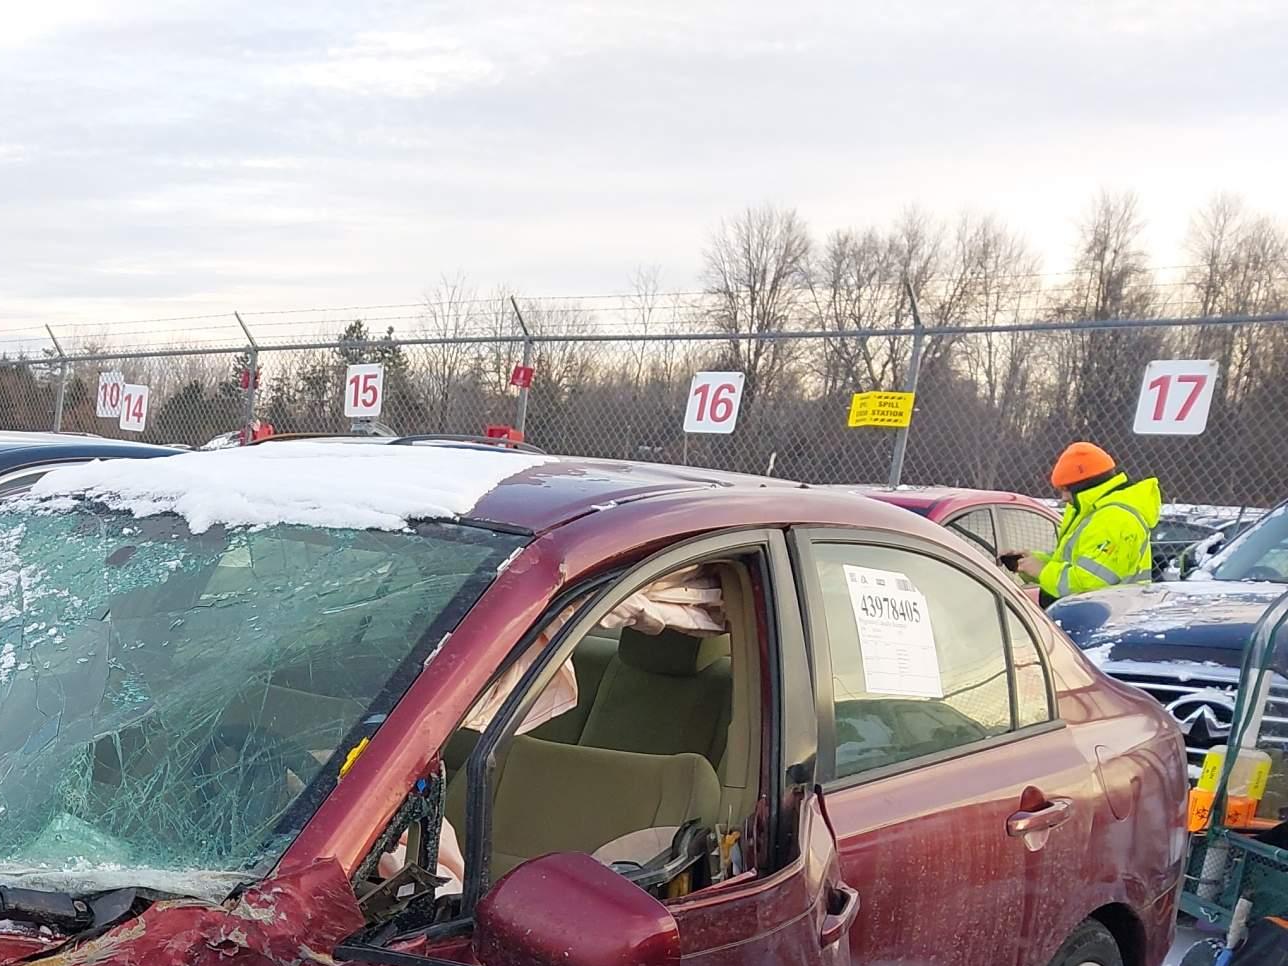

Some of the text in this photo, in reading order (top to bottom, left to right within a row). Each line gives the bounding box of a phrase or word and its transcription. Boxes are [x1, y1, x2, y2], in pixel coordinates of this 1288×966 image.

[101, 382, 120, 408] 10
[349, 373, 378, 408] 15
[694, 383, 736, 423] 16
[878, 400, 900, 408] SPILL
[1148, 374, 1208, 421] 17
[124, 393, 144, 423] 14
[872, 409, 904, 417] STATION
[861, 594, 921, 623] 43978405
